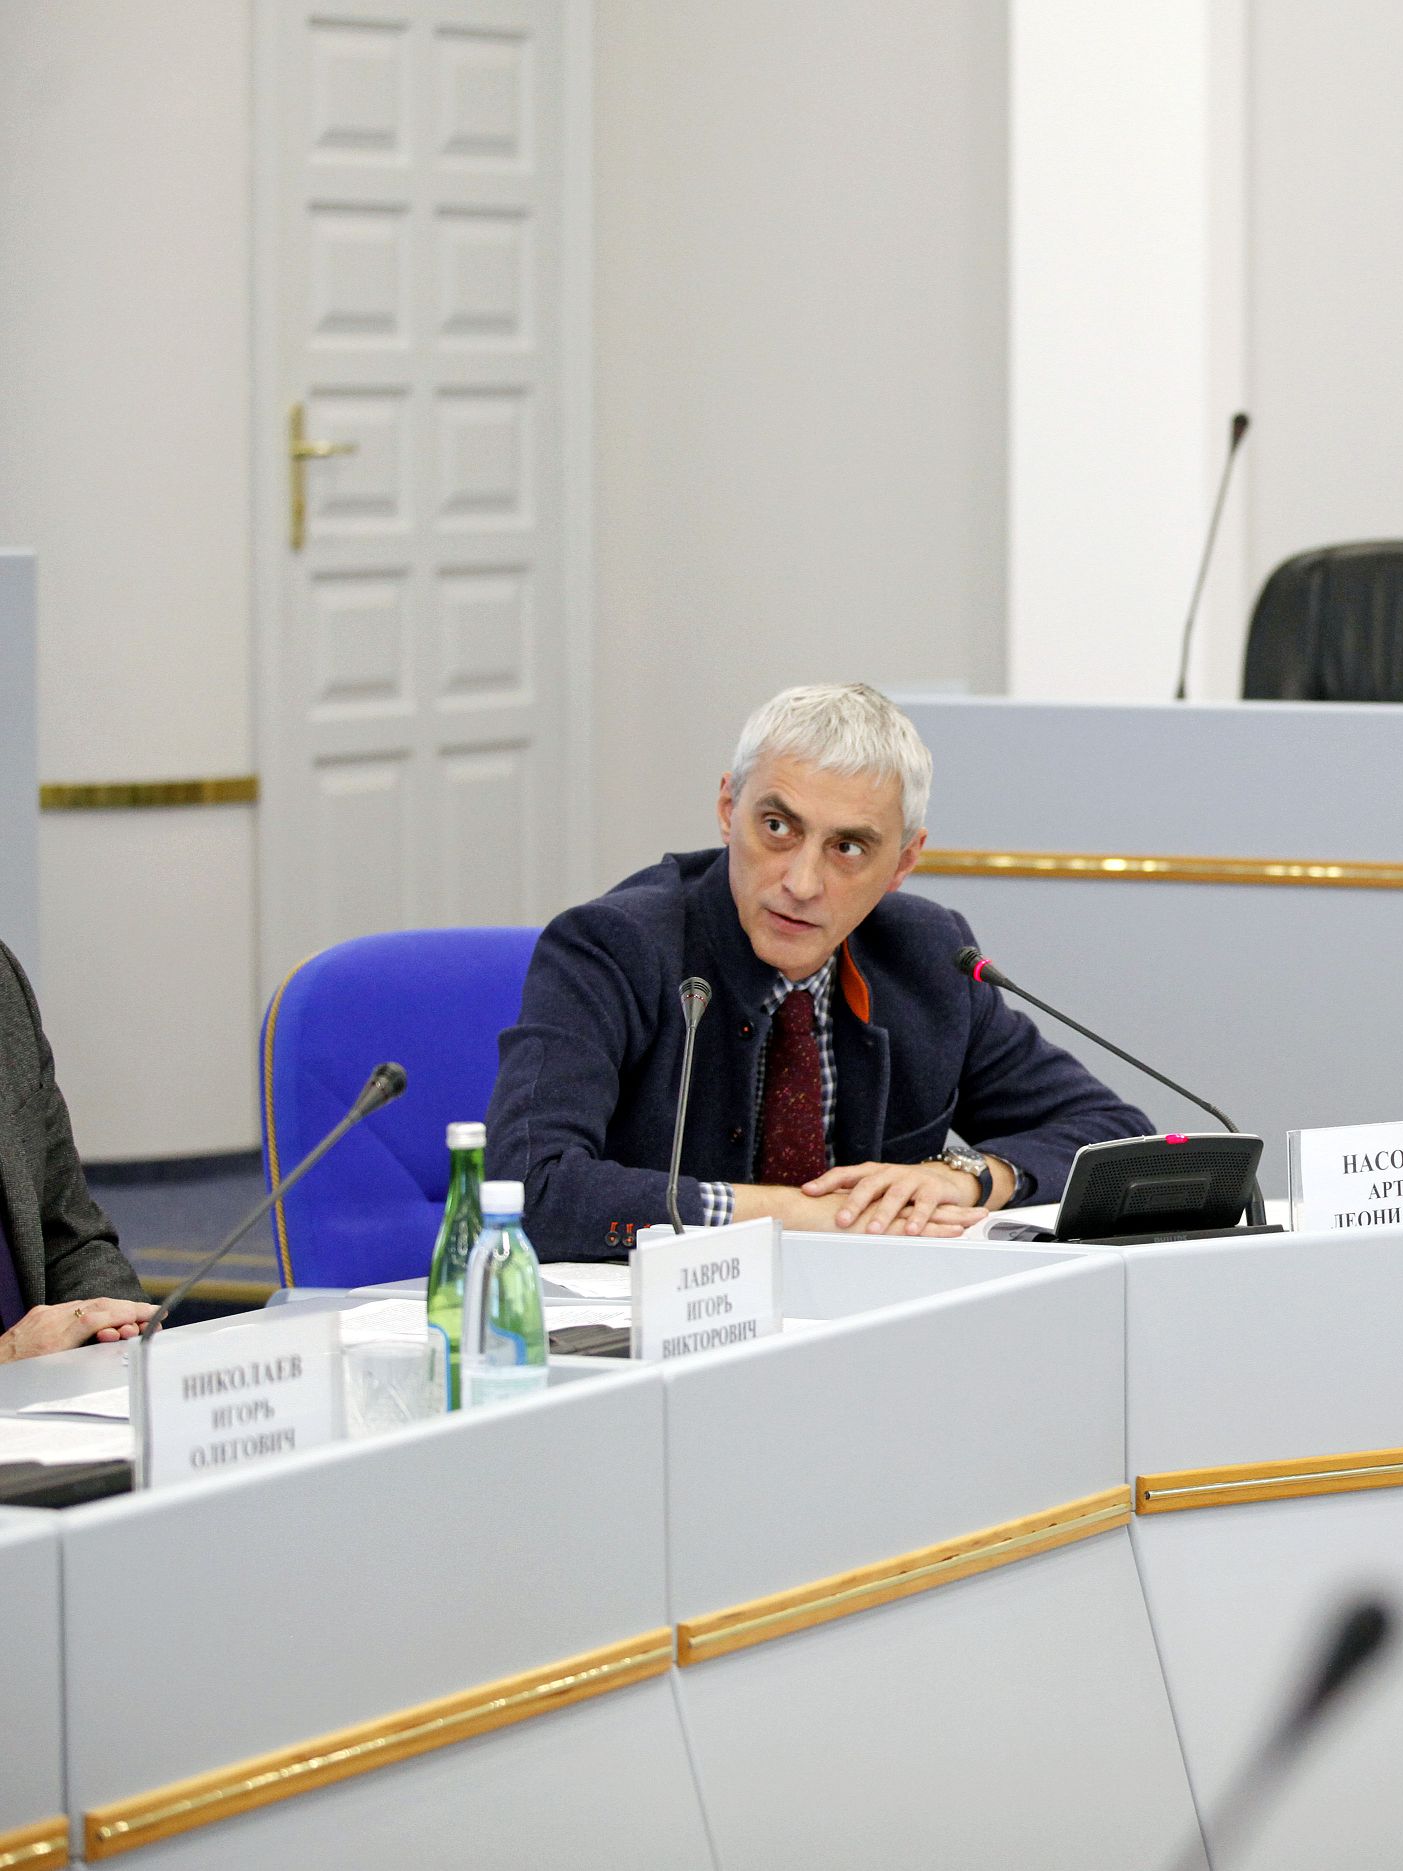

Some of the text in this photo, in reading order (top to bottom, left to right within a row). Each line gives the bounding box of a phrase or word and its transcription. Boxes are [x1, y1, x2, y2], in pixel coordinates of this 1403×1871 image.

[677, 1257, 741, 1291] ЛАВРОВ
[686, 1293, 733, 1322] ИГОРЬ
[662, 1319, 757, 1359] ВИКТОРОВИЧ
[182, 1353, 303, 1401] НИКОЛАЕВ
[211, 1399, 276, 1430] ИГОРЬ
[190, 1427, 296, 1469] ОЛЕГОВИЧ
